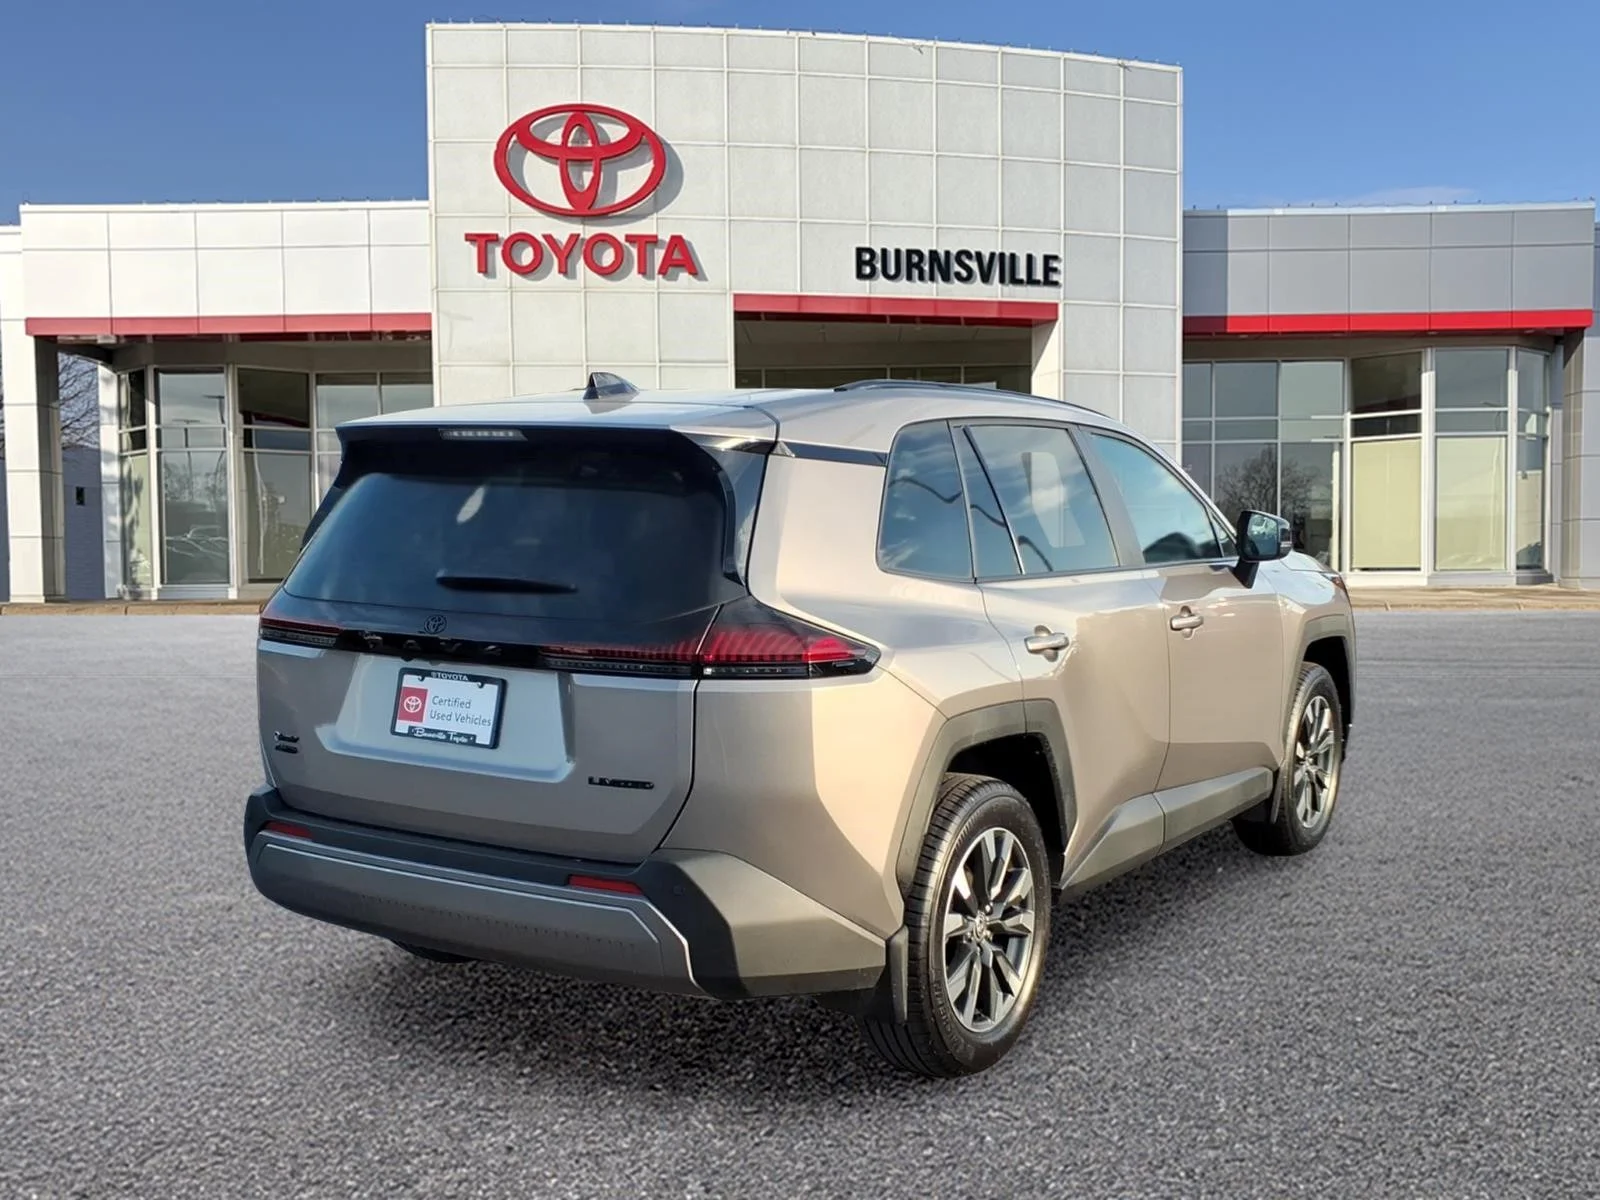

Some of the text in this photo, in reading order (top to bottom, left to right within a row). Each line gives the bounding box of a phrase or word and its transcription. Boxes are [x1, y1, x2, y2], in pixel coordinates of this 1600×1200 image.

[464, 231, 698, 276] TOYOTA
[855, 246, 1062, 287] BURNSVILLE
[437, 672, 469, 681] TOYOTA
[431, 695, 471, 709] Certified
[429, 710, 492, 727] Used Vehicles
